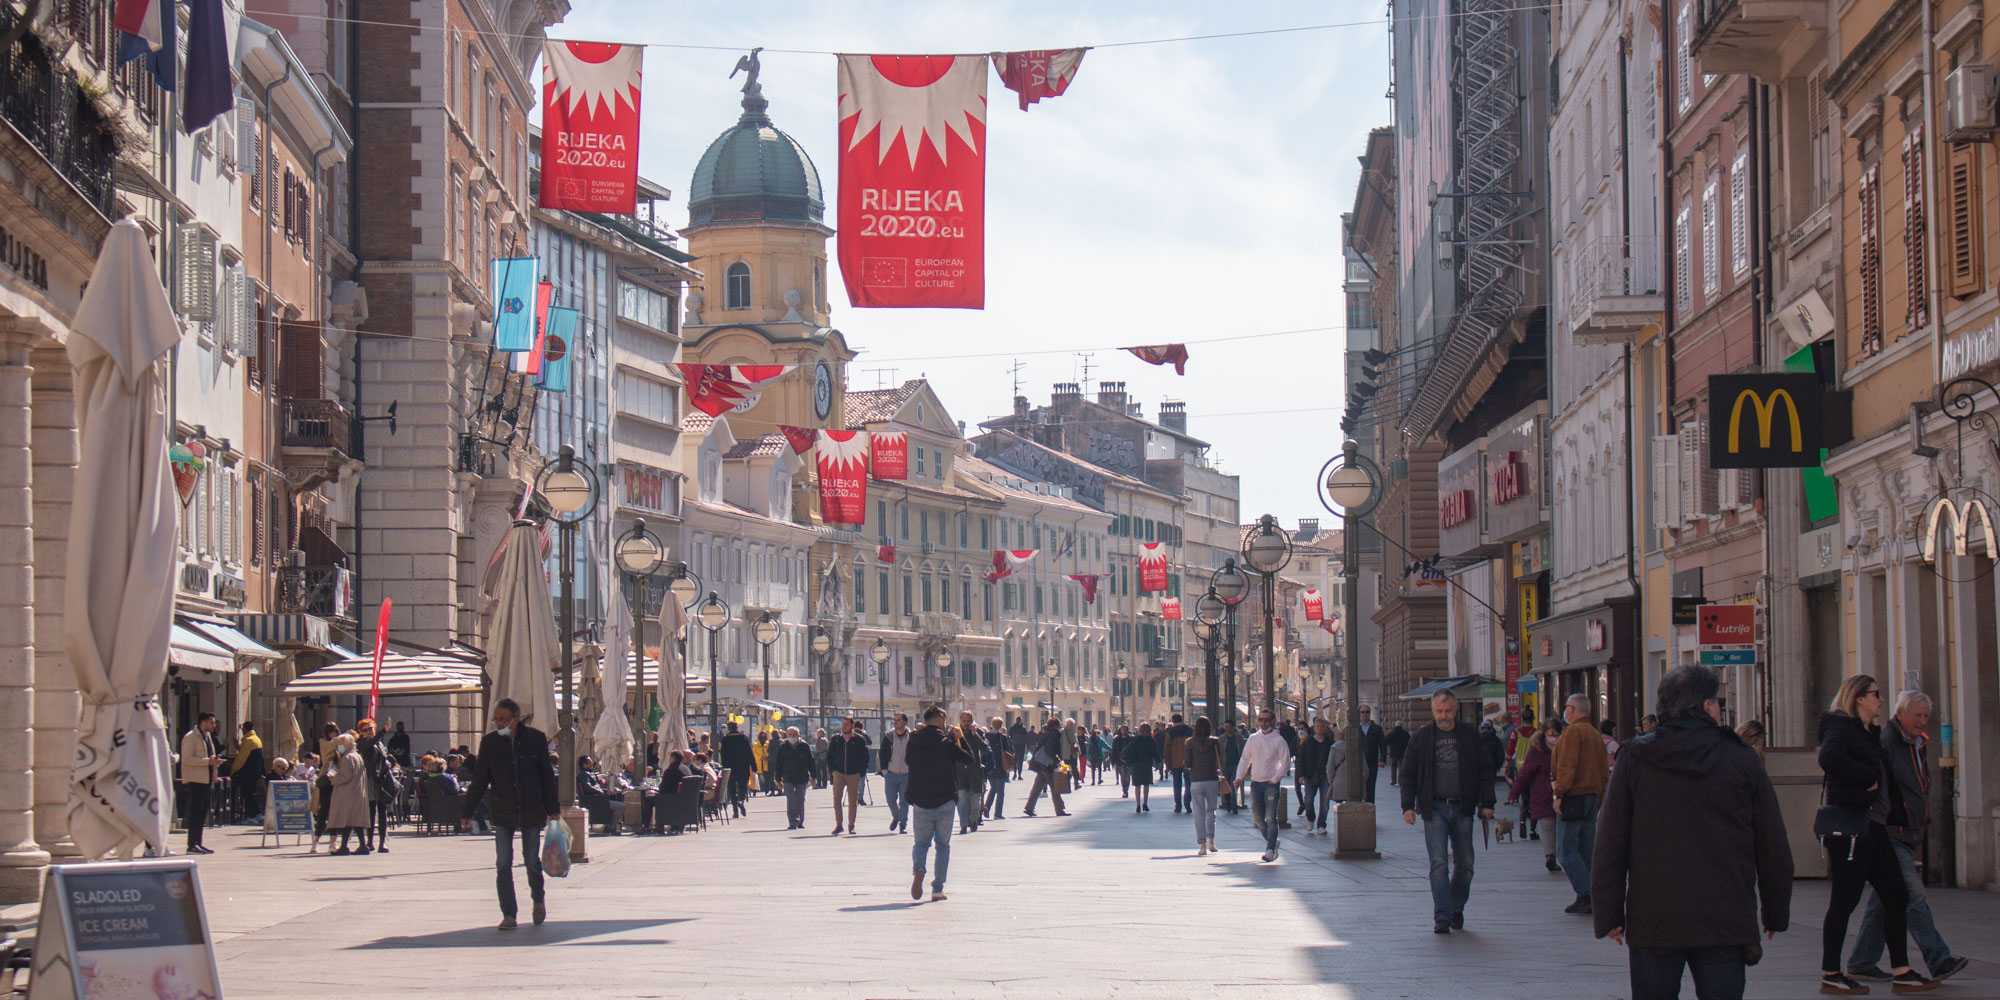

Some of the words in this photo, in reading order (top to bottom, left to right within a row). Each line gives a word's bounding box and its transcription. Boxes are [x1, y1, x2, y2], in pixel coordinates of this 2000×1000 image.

[558, 131, 626, 150] RIJEKA
[556, 149, 626, 168] 2020.eu
[591, 180, 625, 188] EUROPEAN
[861, 188, 964, 212] RIJEKA
[860, 214, 964, 238] 2020.eu
[914, 259, 964, 267] EUROPEAN
[914, 269, 951, 277] CAPITAL
[952, 269, 965, 277] OF
[914, 280, 955, 288] CULTURE
[877, 449, 903, 457] RIJEKA
[821, 478, 859, 488] RIJEKA
[1440, 489, 1468, 529] ROBNA
[1715, 624, 1750, 636] Lutrija
[72, 888, 142, 904] SLADOLED
[78, 919, 102, 933] ICE
[103, 917, 149, 932] CREAM
